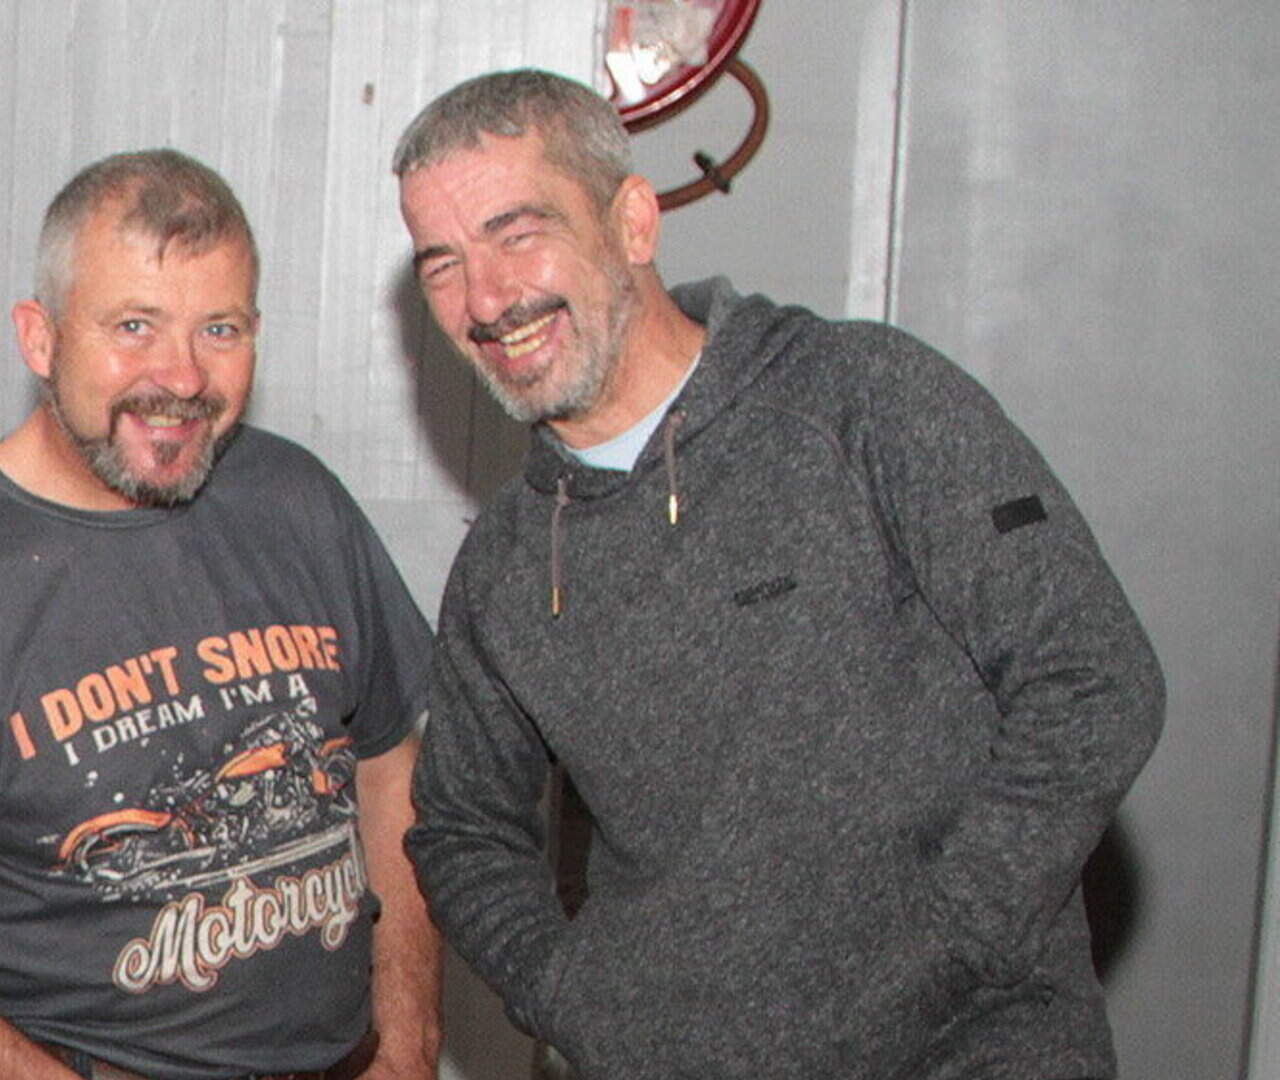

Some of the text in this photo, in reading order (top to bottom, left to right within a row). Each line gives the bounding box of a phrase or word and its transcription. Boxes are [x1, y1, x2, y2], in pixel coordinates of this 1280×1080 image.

[9, 624, 341, 760] I DON'T SNORE
[63, 673, 310, 766] I DREAM I'M A
[112, 840, 365, 992] Motorcycl
